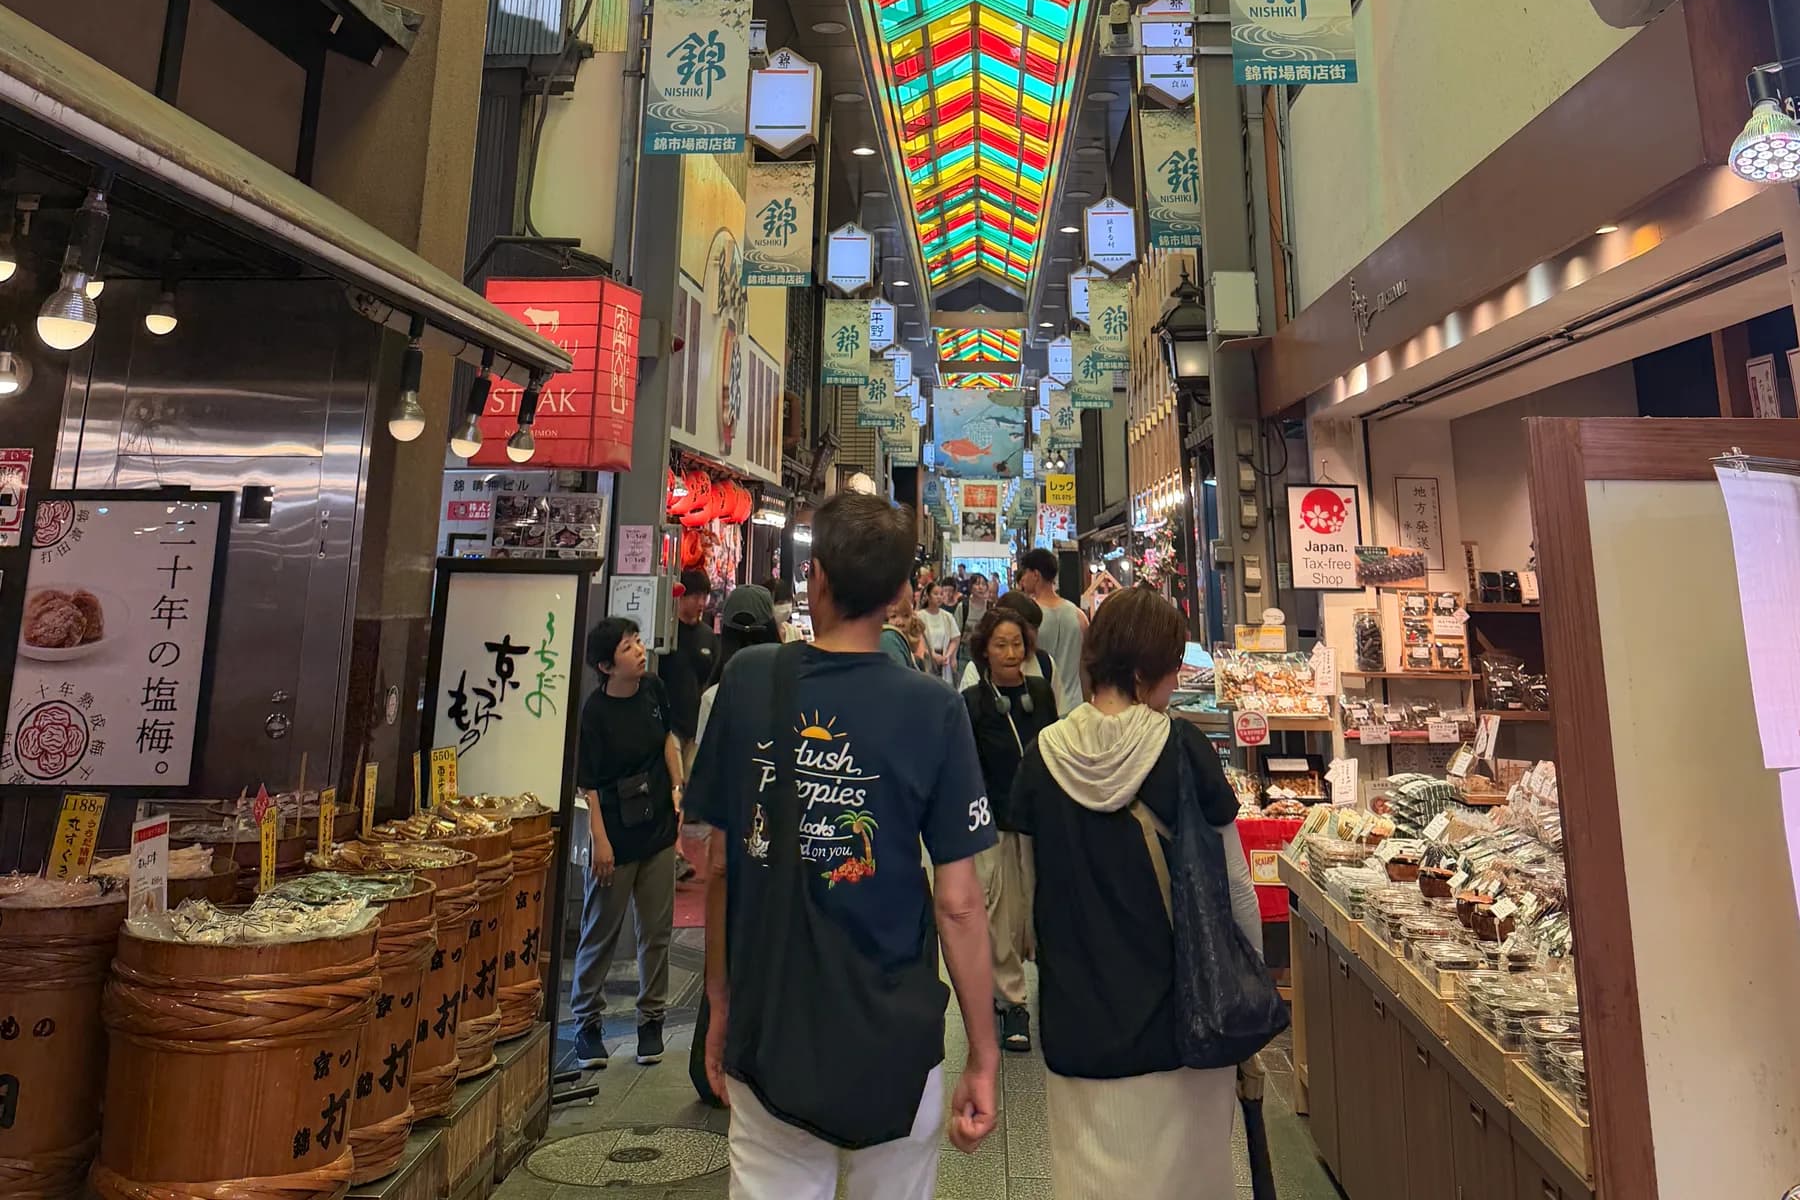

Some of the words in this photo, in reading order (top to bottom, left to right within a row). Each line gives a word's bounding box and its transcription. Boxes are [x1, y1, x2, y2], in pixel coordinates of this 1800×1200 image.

[1249, 5, 1298, 17] NISHIKI
[666, 30, 726, 100] 錦
[1244, 62, 1347, 81] 錦市場商店街
[664, 87, 704, 97] NISHIKI
[653, 136, 737, 152] 錦市場商店街
[1157, 148, 1199, 204] 錦
[1160, 194, 1192, 203] NISHIKI
[756, 197, 798, 248] 錦
[754, 239, 782, 247] NISHIKI
[1158, 235, 1202, 246] 錦市場商
[871, 311, 884, 337] 平野
[1097, 304, 1128, 341] 錦
[831, 325, 860, 358] 錦
[490, 388, 577, 413] STAK
[868, 377, 887, 405] 錦
[1055, 406, 1075, 431] 錦
[504, 429, 558, 438] NIMON
[1413, 485, 1432, 550] 地方発送
[1304, 539, 1348, 555] Japan.
[1302, 556, 1352, 570] Tax-free
[1312, 572, 1344, 587] Shop
[136, 519, 197, 775] 二十年の塩梅。
[525, 611, 566, 719] うちだの
[758, 766, 867, 810] Ppies
[968, 797, 991, 832] 58
[811, 849, 826, 858] on
[316, 1088, 350, 1150] 打
